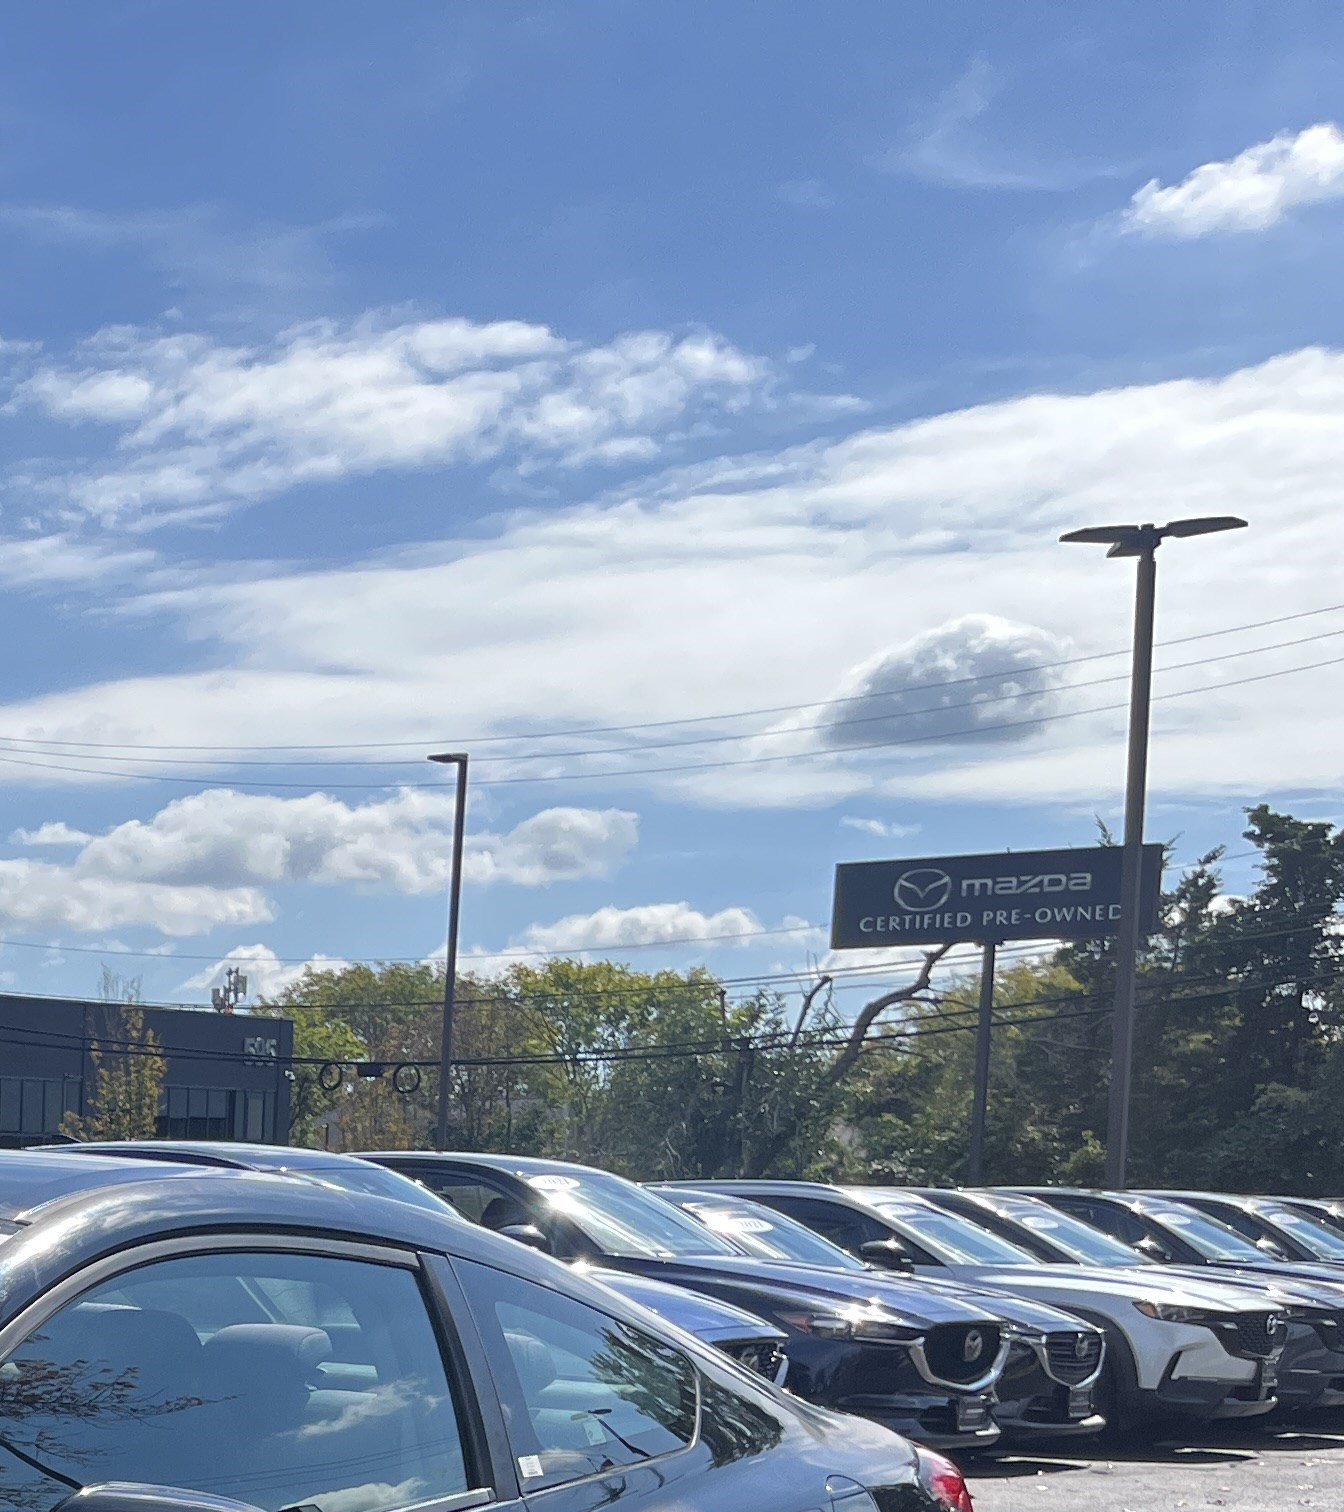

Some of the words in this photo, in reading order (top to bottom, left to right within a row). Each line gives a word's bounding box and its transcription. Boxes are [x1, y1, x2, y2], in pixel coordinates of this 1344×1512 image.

[962, 872, 1092, 897] mazda
[859, 911, 971, 932] CERTIFIED
[983, 904, 1122, 926] PRE-OWNED
